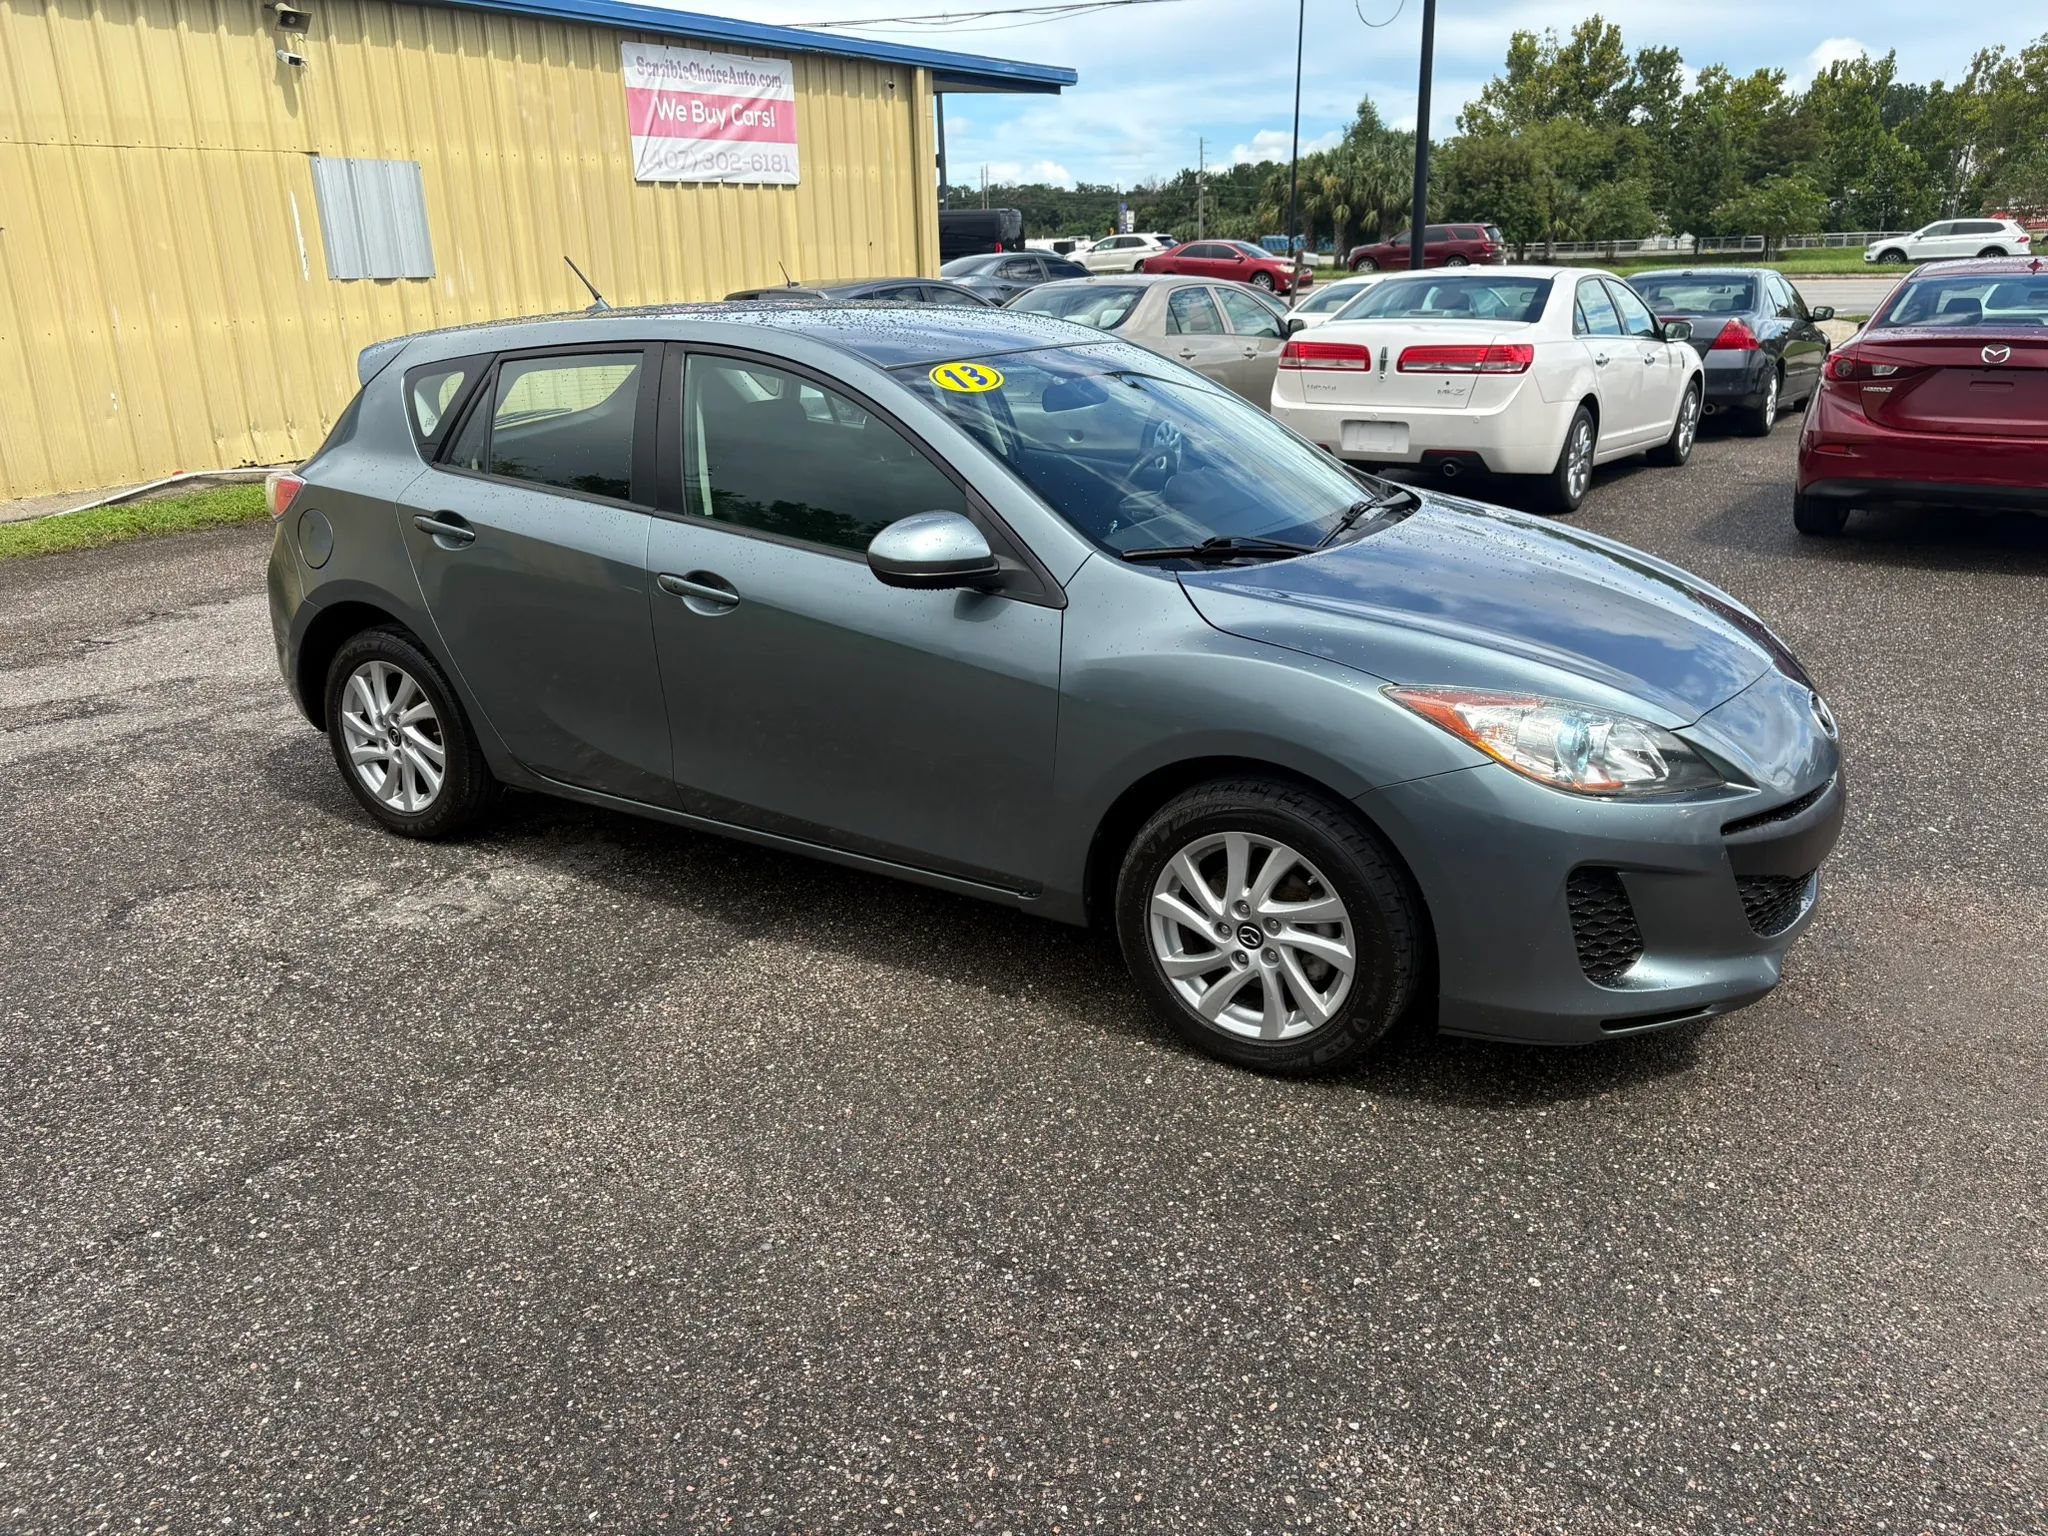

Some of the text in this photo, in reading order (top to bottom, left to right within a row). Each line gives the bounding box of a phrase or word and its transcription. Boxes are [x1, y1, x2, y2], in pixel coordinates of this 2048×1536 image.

[655, 96, 775, 130] We Buy Cars!
[703, 153, 791, 173] 302-6181
[943, 366, 988, 388] 13
